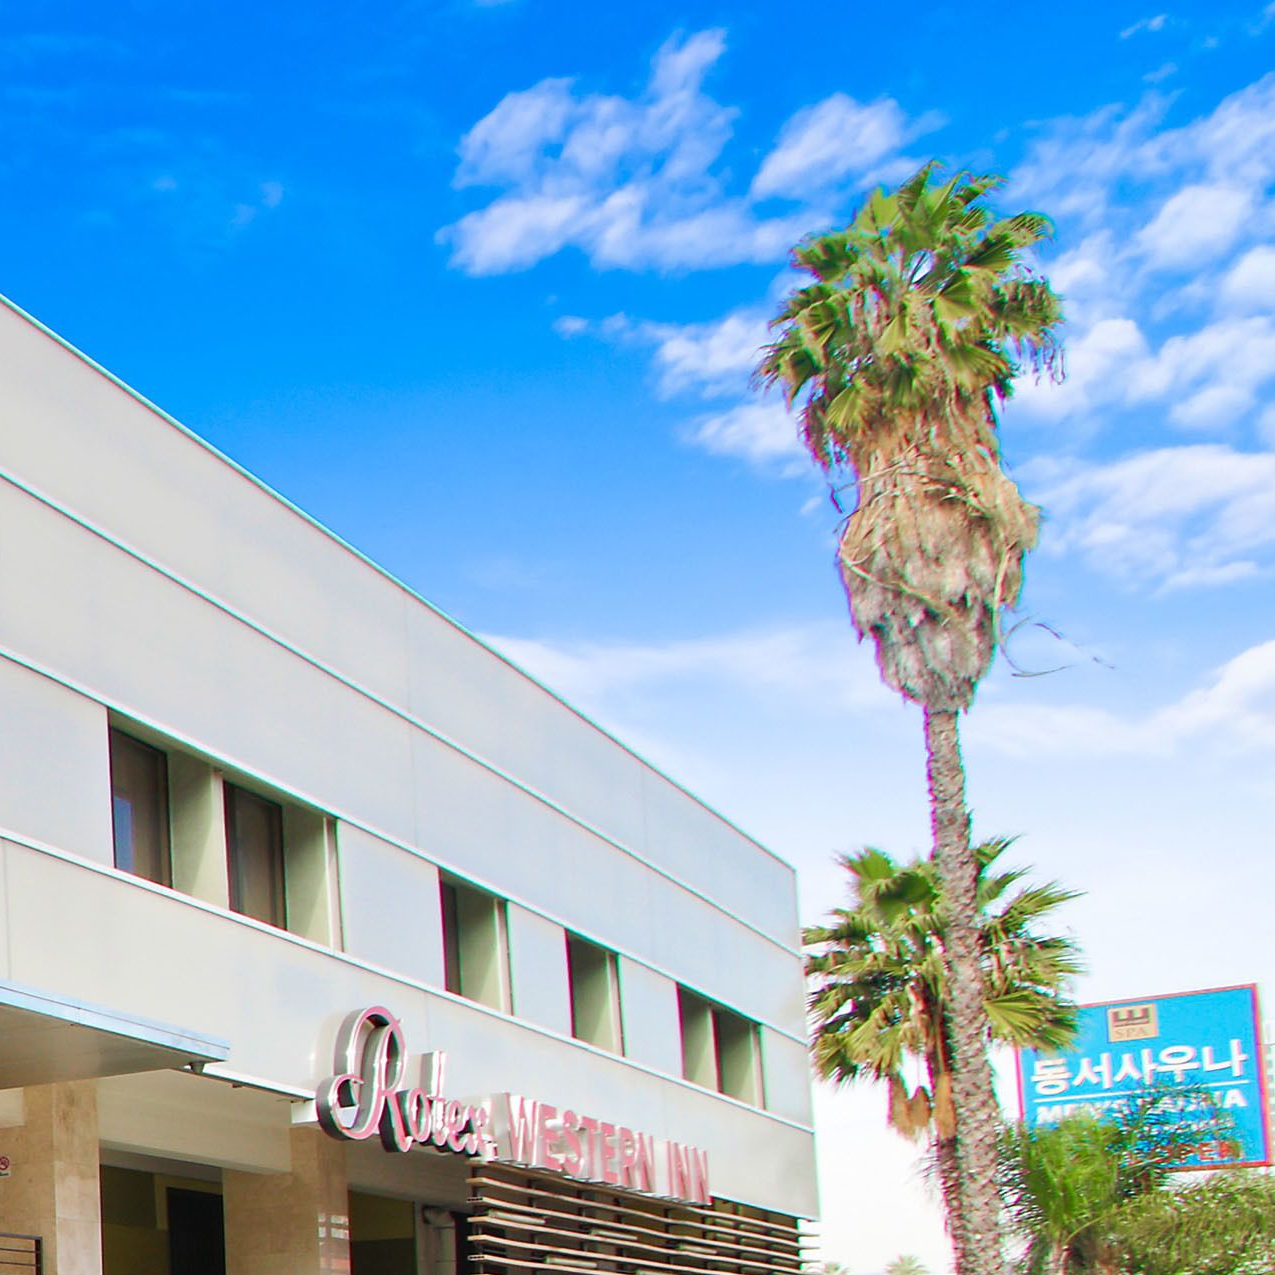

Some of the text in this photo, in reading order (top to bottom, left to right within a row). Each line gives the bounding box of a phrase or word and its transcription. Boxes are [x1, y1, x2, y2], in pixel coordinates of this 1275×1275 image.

[1114, 1026, 1147, 1039] SPA
[1031, 1039, 1249, 1095] 동서사우나
[317, 1005, 712, 1207] Rotex WESTERN INN
